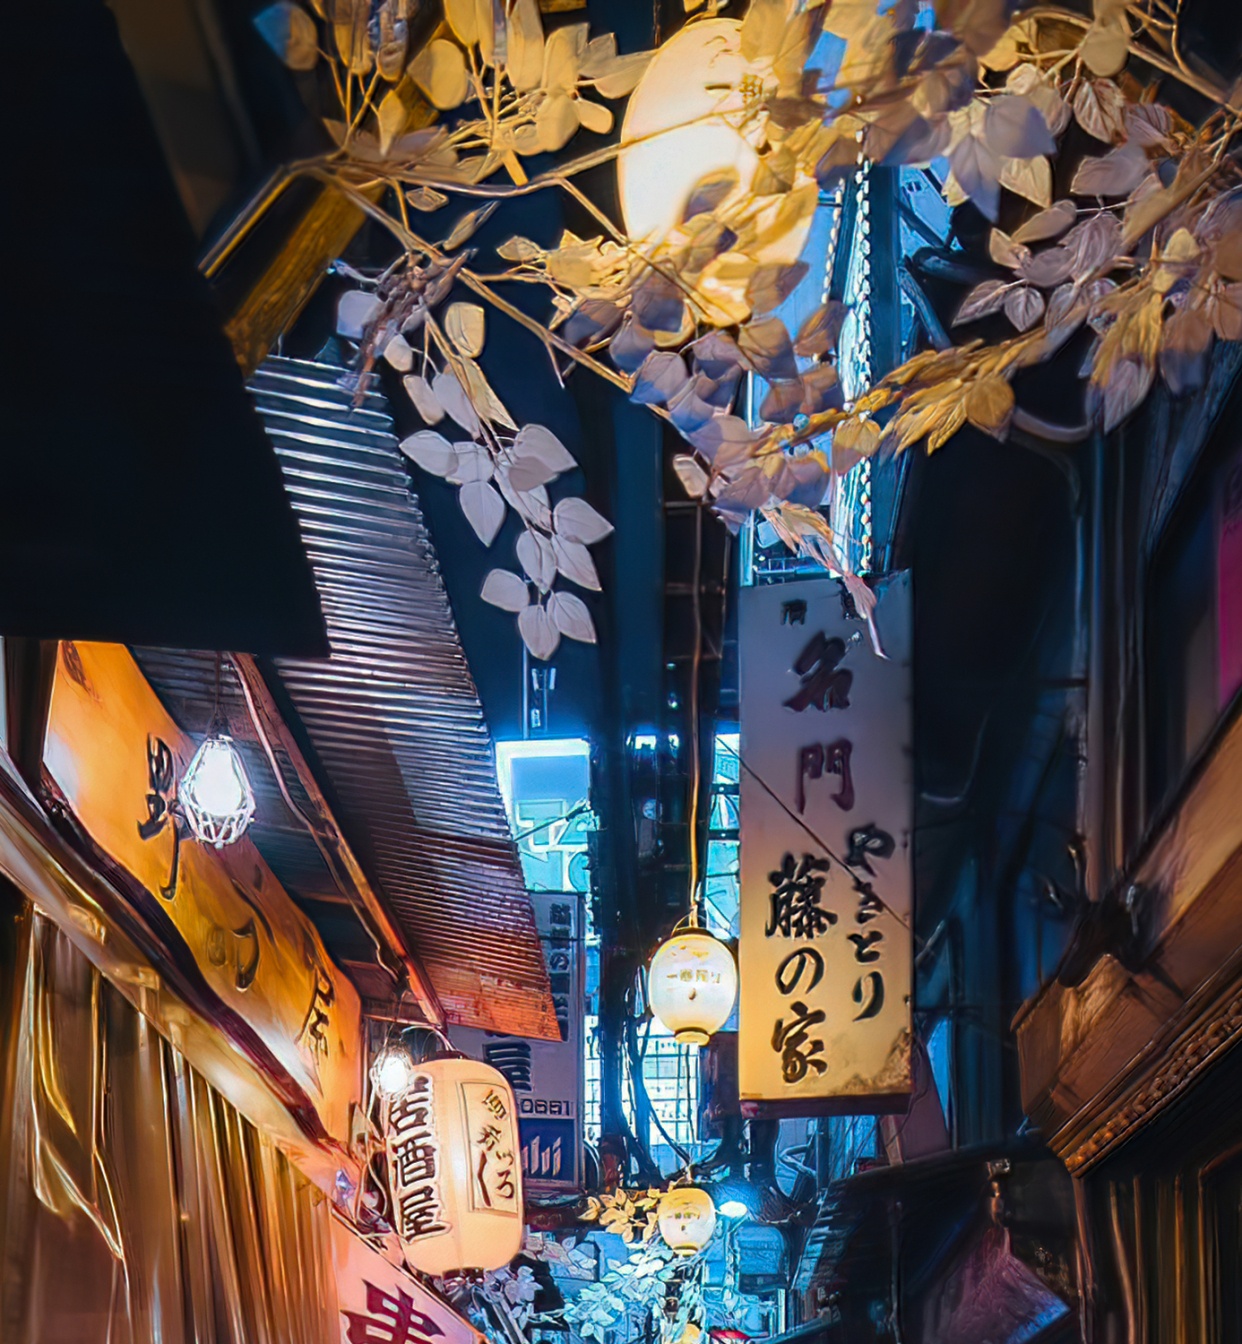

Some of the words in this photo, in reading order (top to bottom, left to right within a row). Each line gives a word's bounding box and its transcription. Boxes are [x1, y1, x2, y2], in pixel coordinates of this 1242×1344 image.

[783, 632, 855, 815] 名門
[765, 852, 837, 1084] 藤の家
[844, 823, 896, 1022] やきとり
